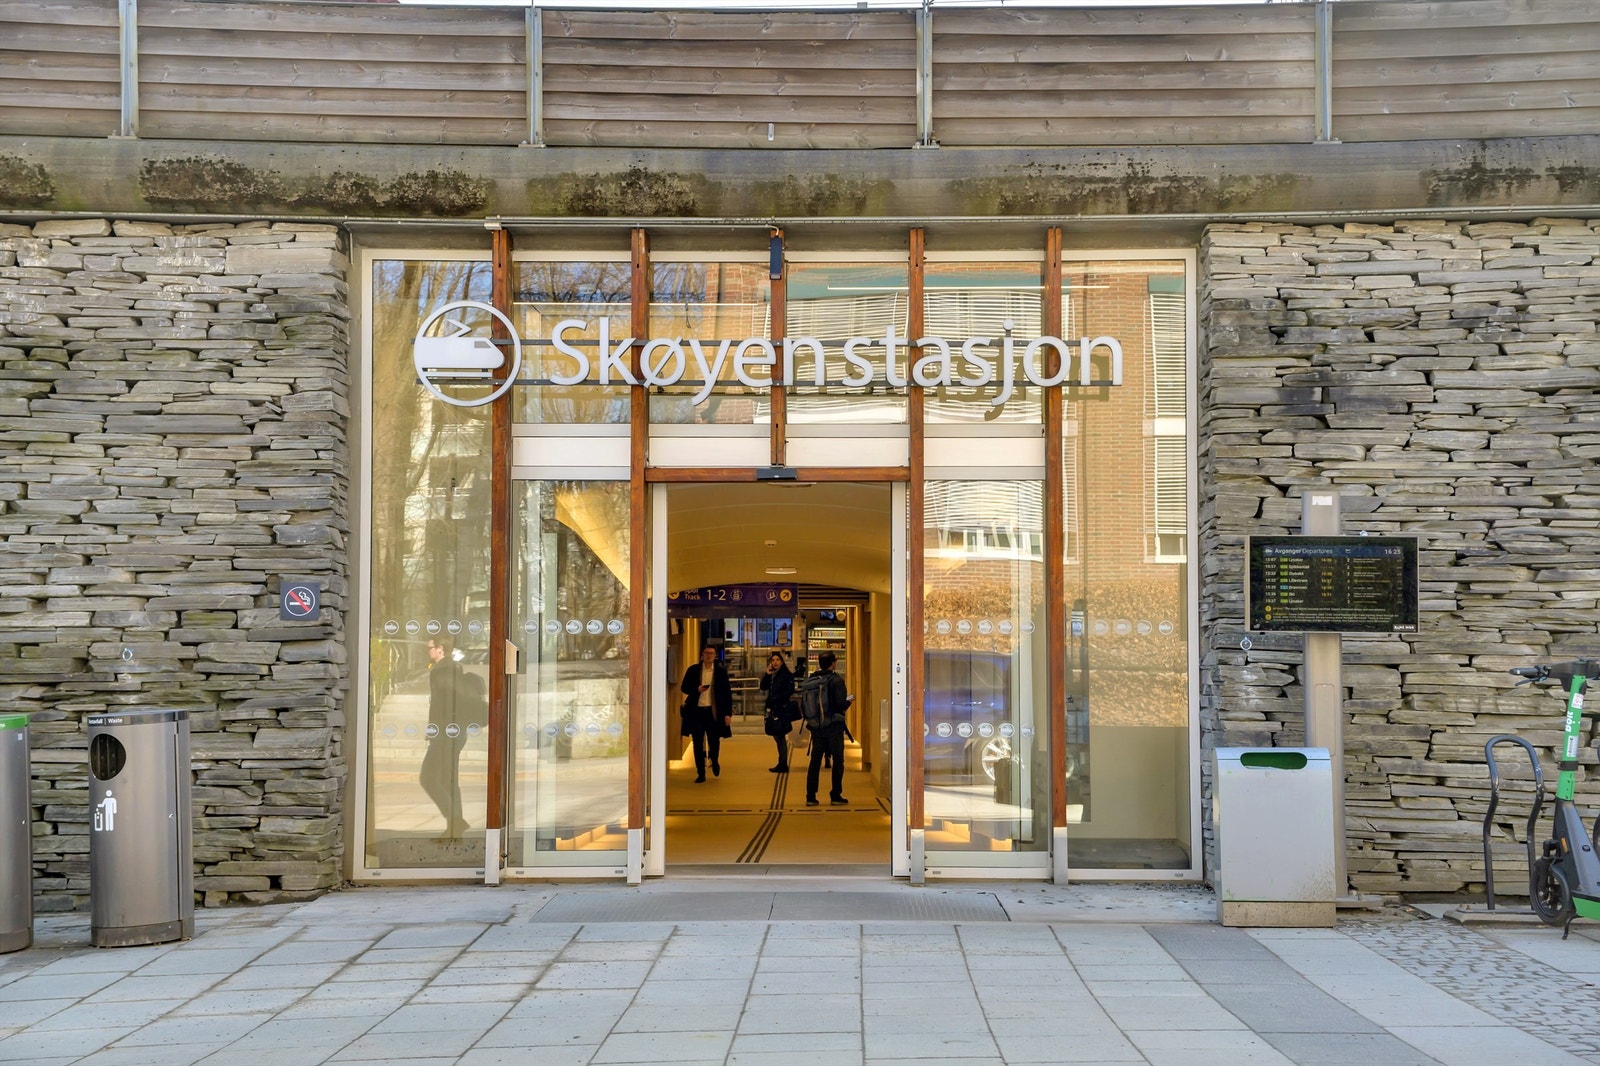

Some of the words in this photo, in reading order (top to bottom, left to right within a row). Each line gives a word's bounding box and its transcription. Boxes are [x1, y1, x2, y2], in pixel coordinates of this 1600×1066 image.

[549, 318, 824, 406] Skøyen
[842, 320, 1122, 406] stasjon
[706, 589, 726, 601] 1-2
[1565, 710, 1574, 733] Bolt
